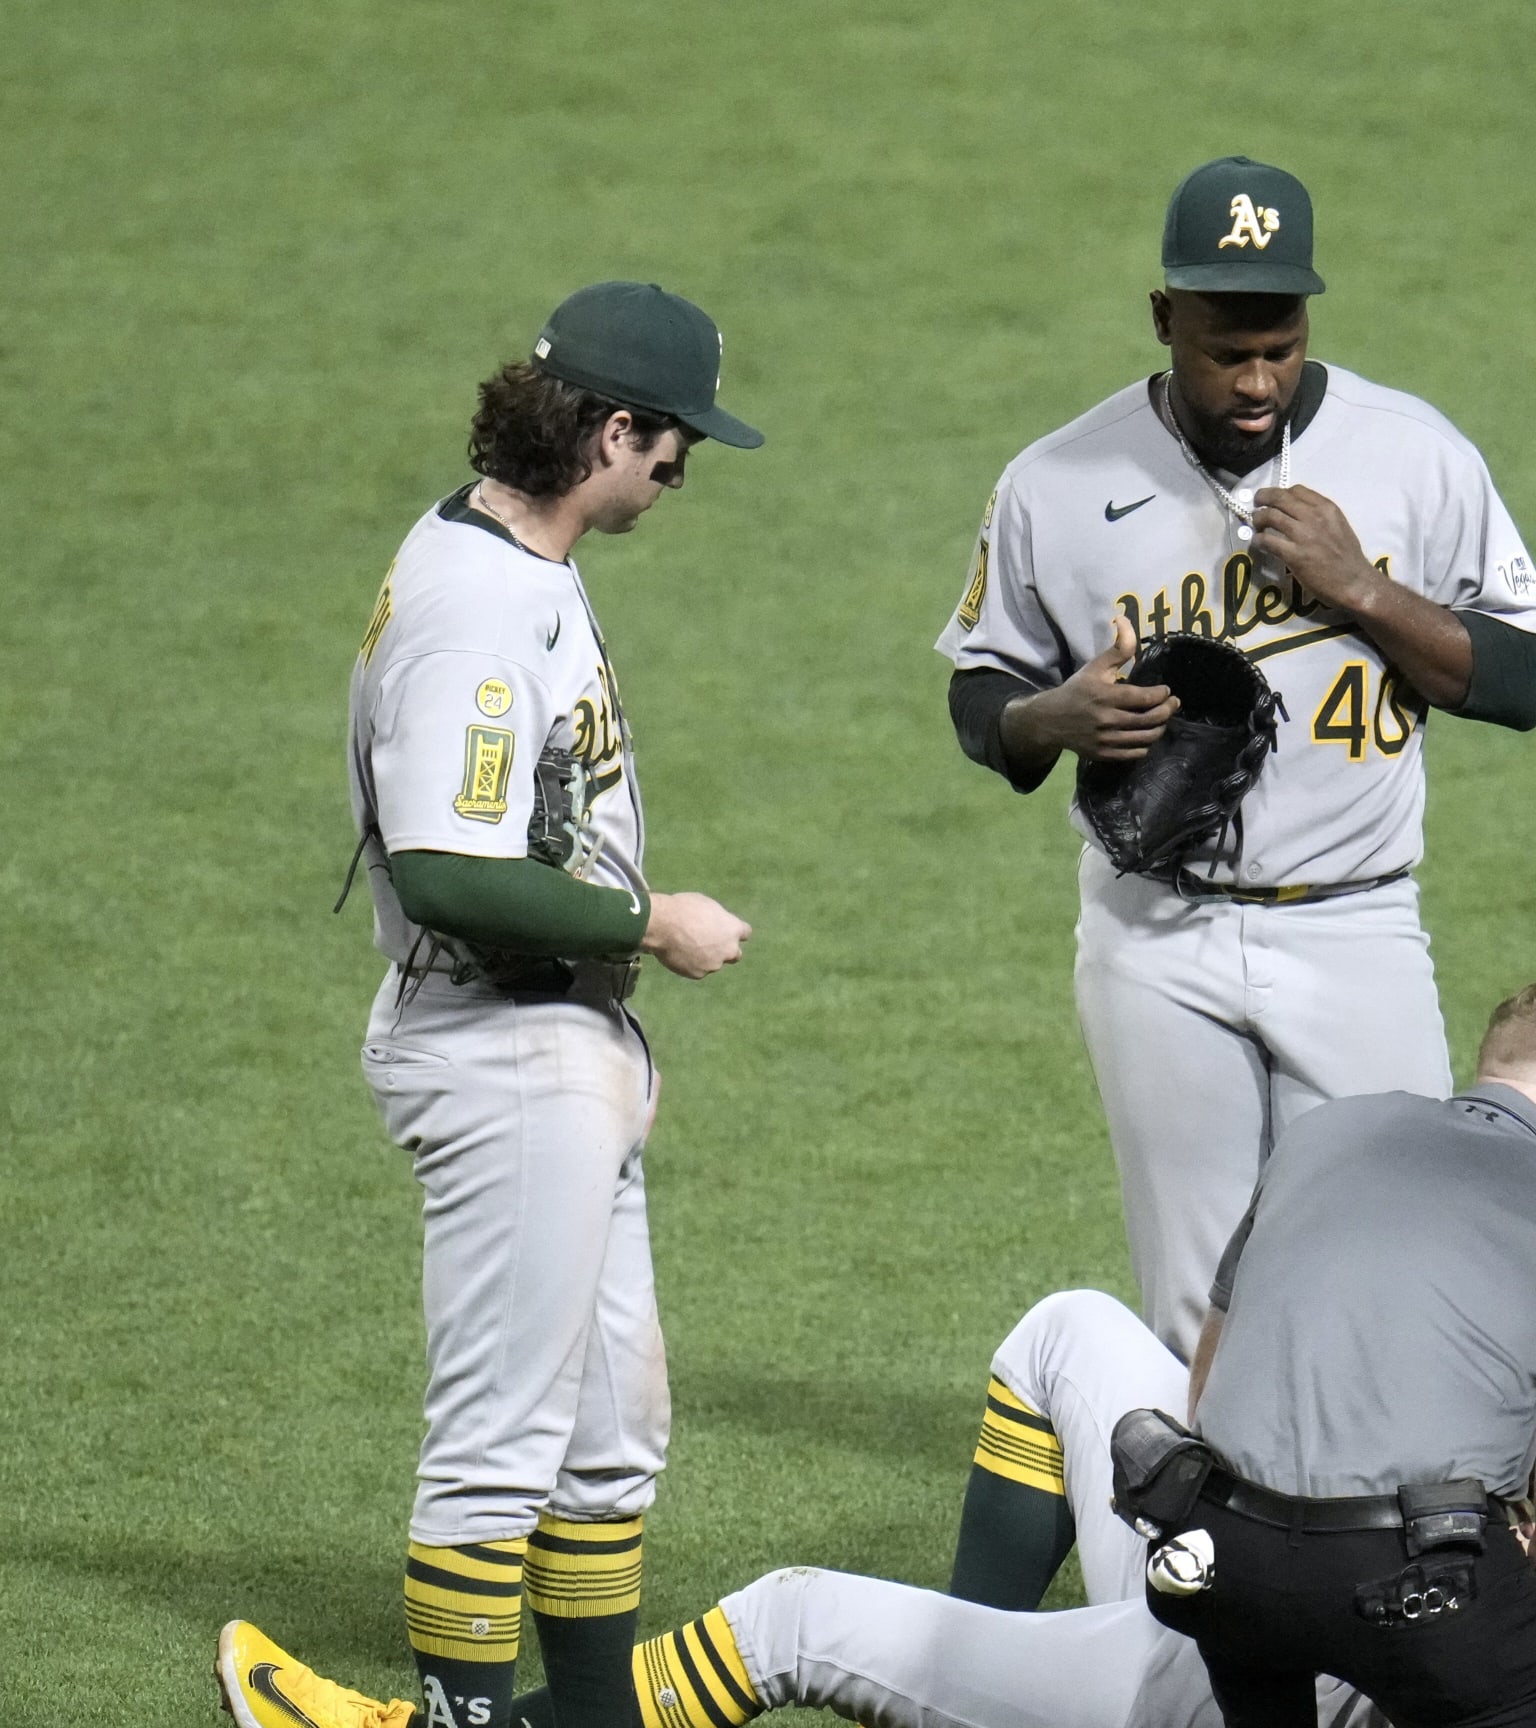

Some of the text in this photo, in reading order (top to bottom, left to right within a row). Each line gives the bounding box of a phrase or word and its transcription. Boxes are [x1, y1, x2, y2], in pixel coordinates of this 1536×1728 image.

[1218, 193, 1280, 250] A's
[484, 693, 503, 710] 24
[1310, 659, 1418, 763] 40
[425, 1674, 491, 1728] A's
